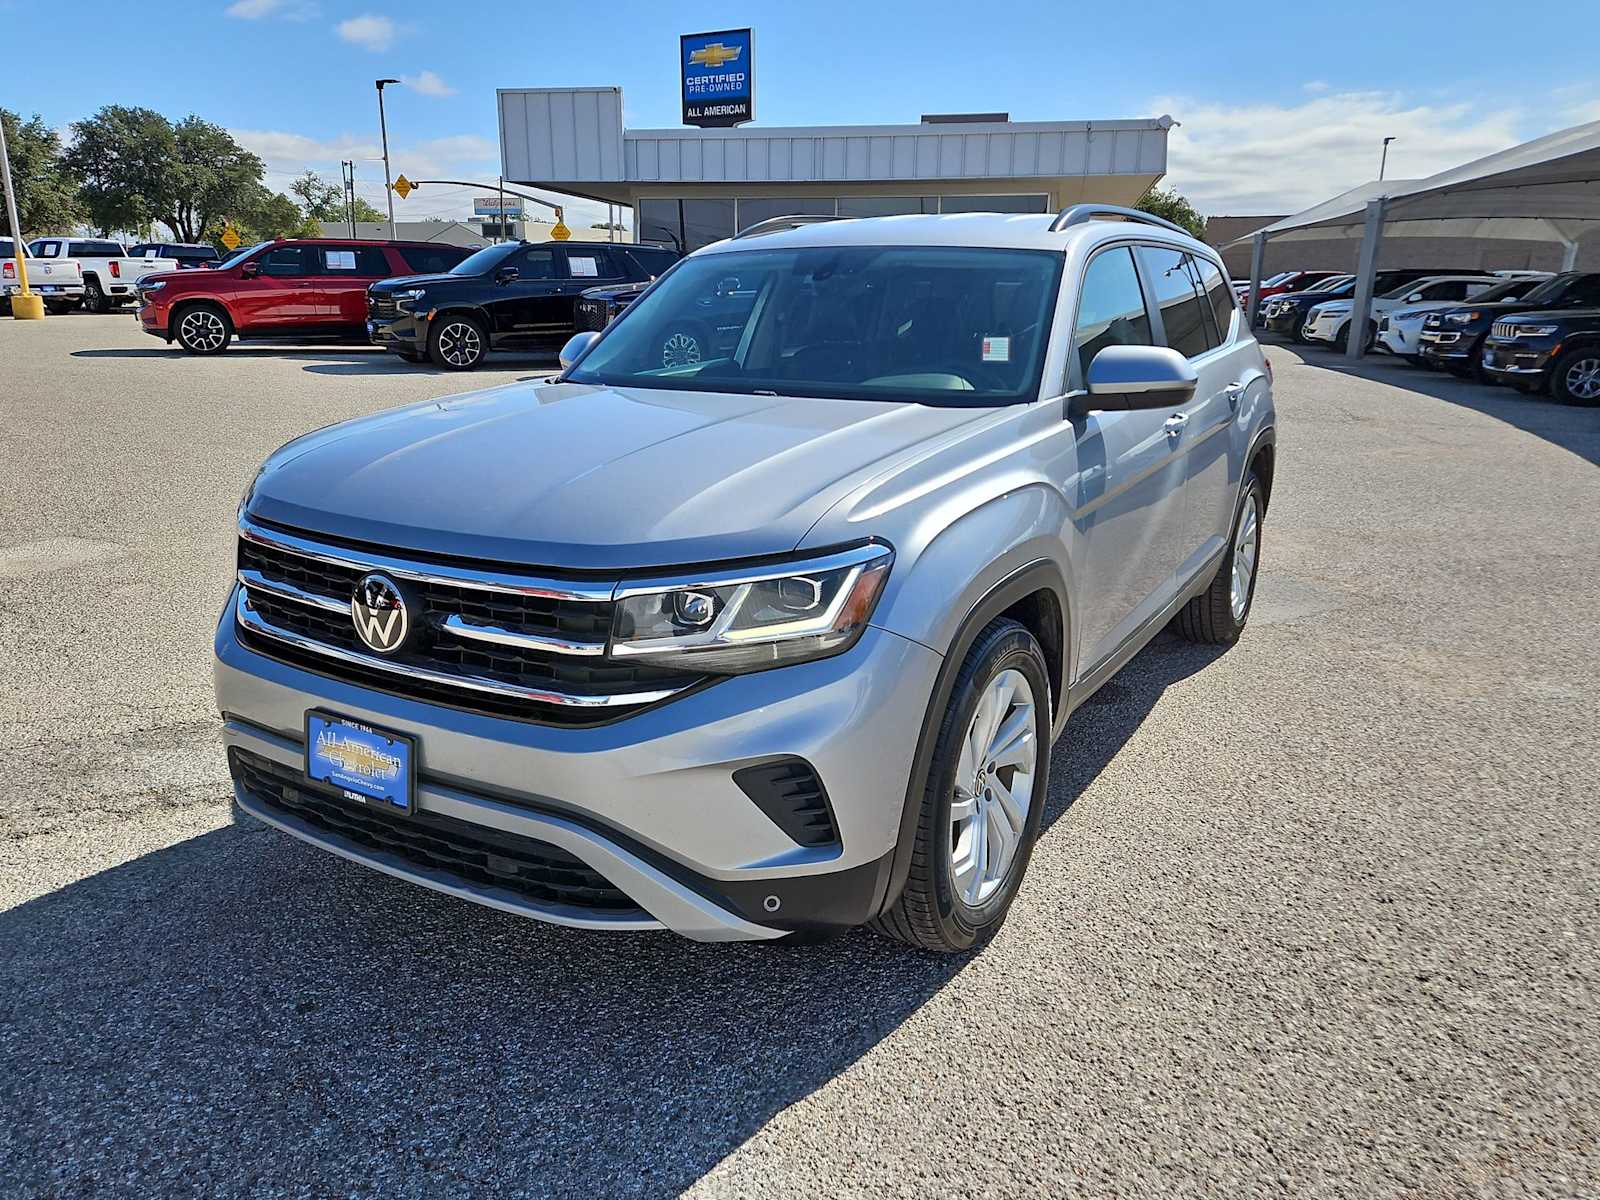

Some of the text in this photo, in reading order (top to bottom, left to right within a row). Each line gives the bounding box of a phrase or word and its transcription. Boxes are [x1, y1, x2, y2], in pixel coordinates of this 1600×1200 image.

[686, 73, 745, 86] CERTIFIED
[689, 83, 742, 94] PRE-OWNED
[687, 104, 746, 118] ALL AMERICAN
[316, 730, 401, 768] All American
